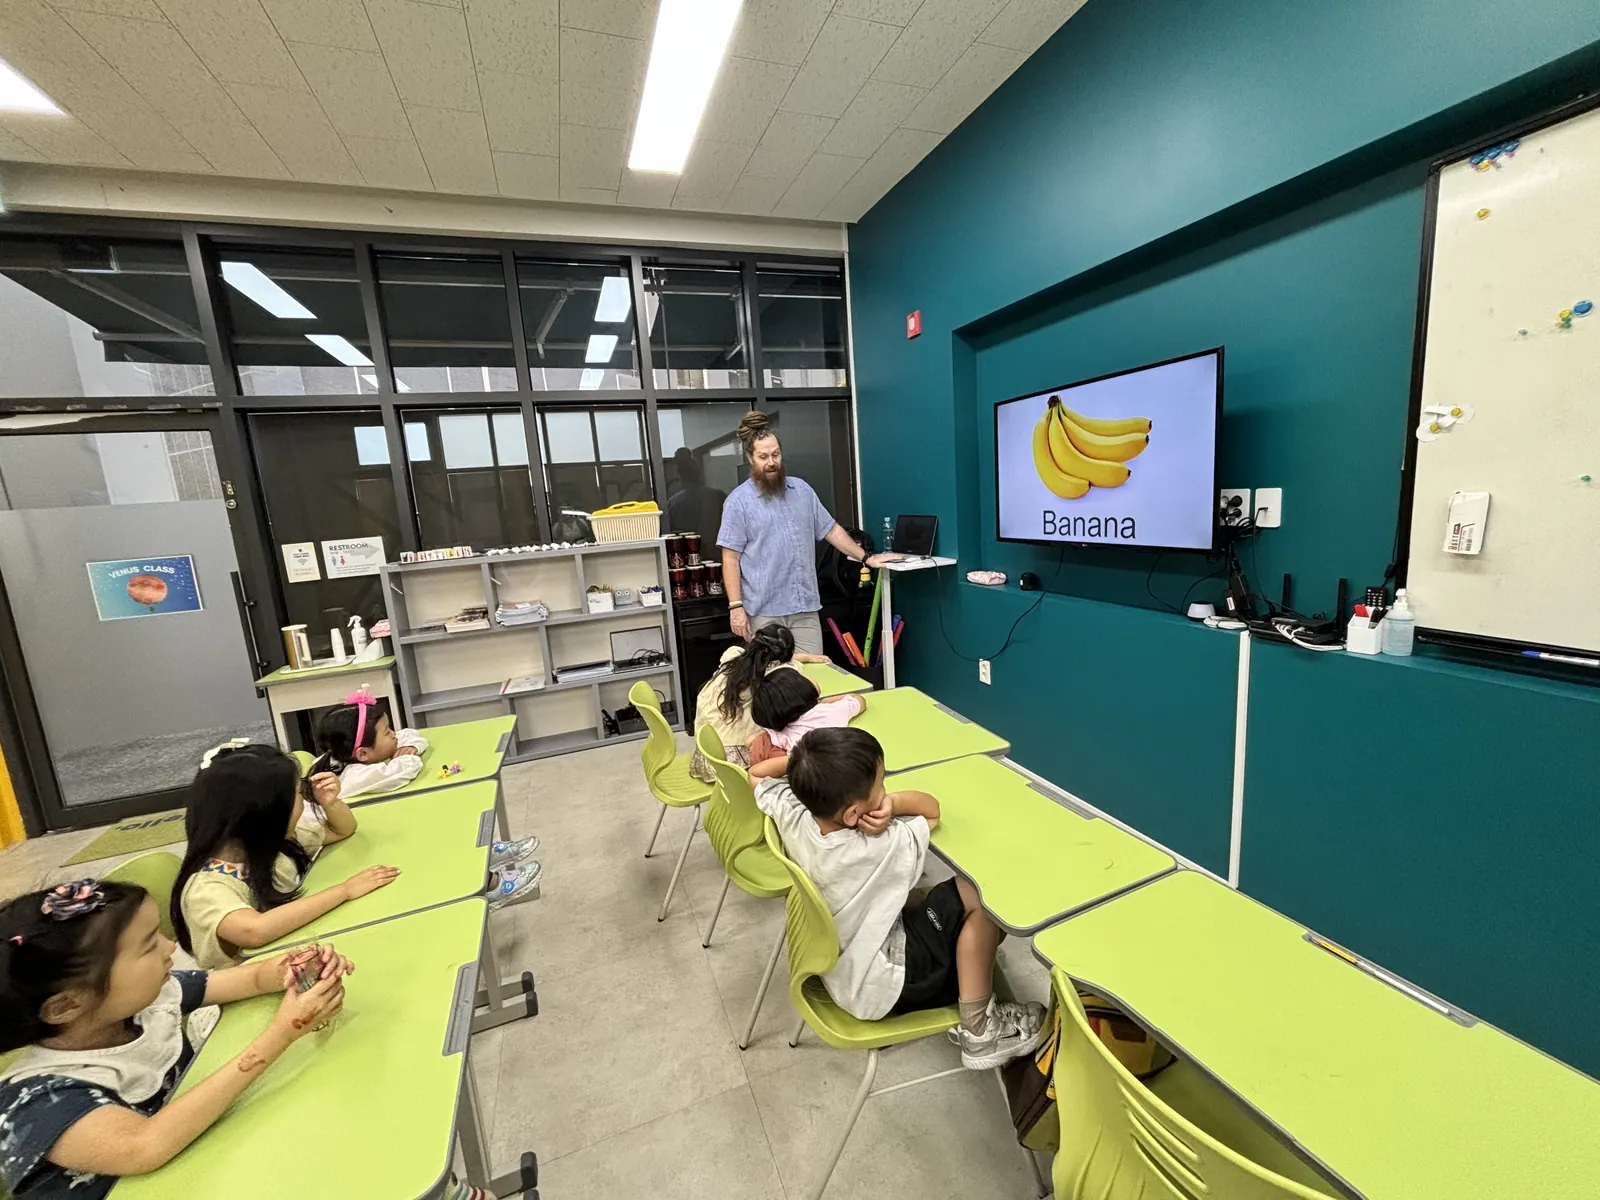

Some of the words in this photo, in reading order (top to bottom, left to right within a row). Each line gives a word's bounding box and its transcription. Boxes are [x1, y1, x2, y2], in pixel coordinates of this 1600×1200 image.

[1043, 510, 1136, 539] Banana
[329, 543, 368, 551] RESTROOM
[108, 566, 139, 578] VENUS
[143, 565, 175, 574] CLASS
[115, 815, 185, 830] ello.
